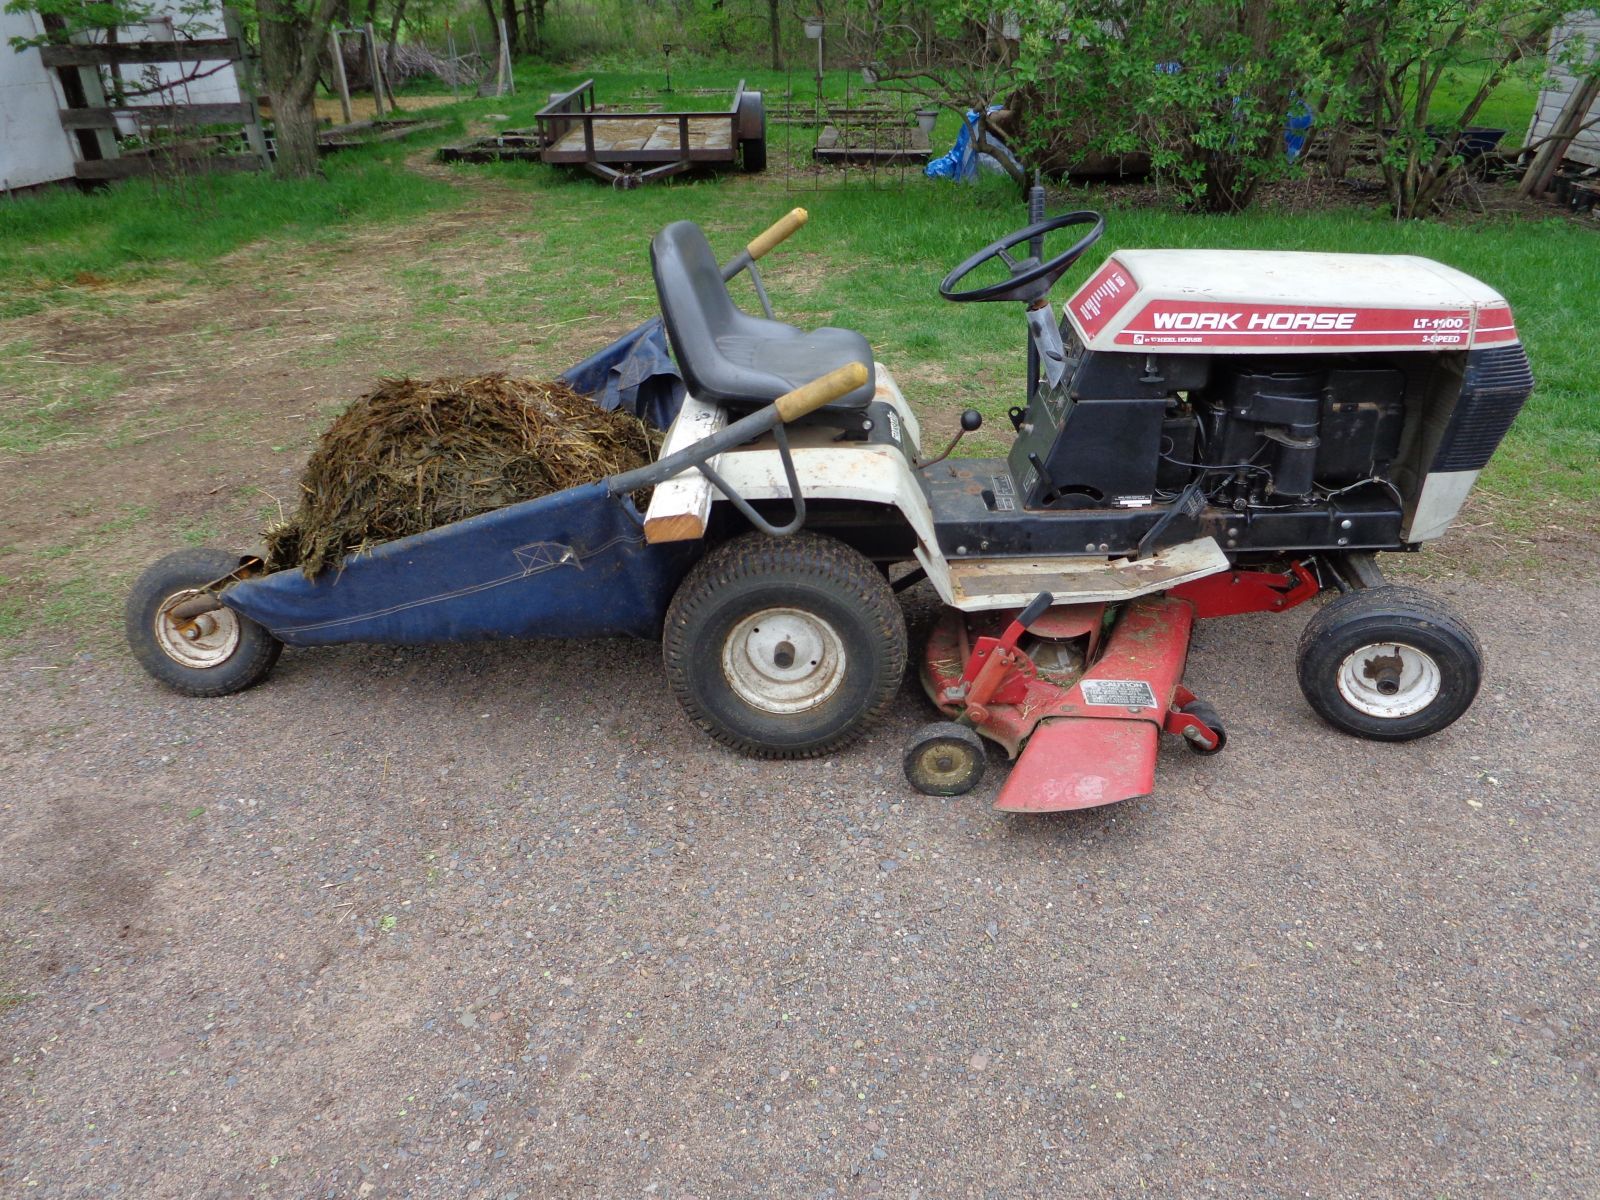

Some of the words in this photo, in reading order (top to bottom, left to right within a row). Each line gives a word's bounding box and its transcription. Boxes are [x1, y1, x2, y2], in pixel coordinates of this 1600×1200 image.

[1153, 312, 1243, 329] WORK
[1247, 313, 1357, 329] HORSE
[1413, 318, 1464, 329] LT-1100
[1422, 335, 1460, 343] 3-SPEED
